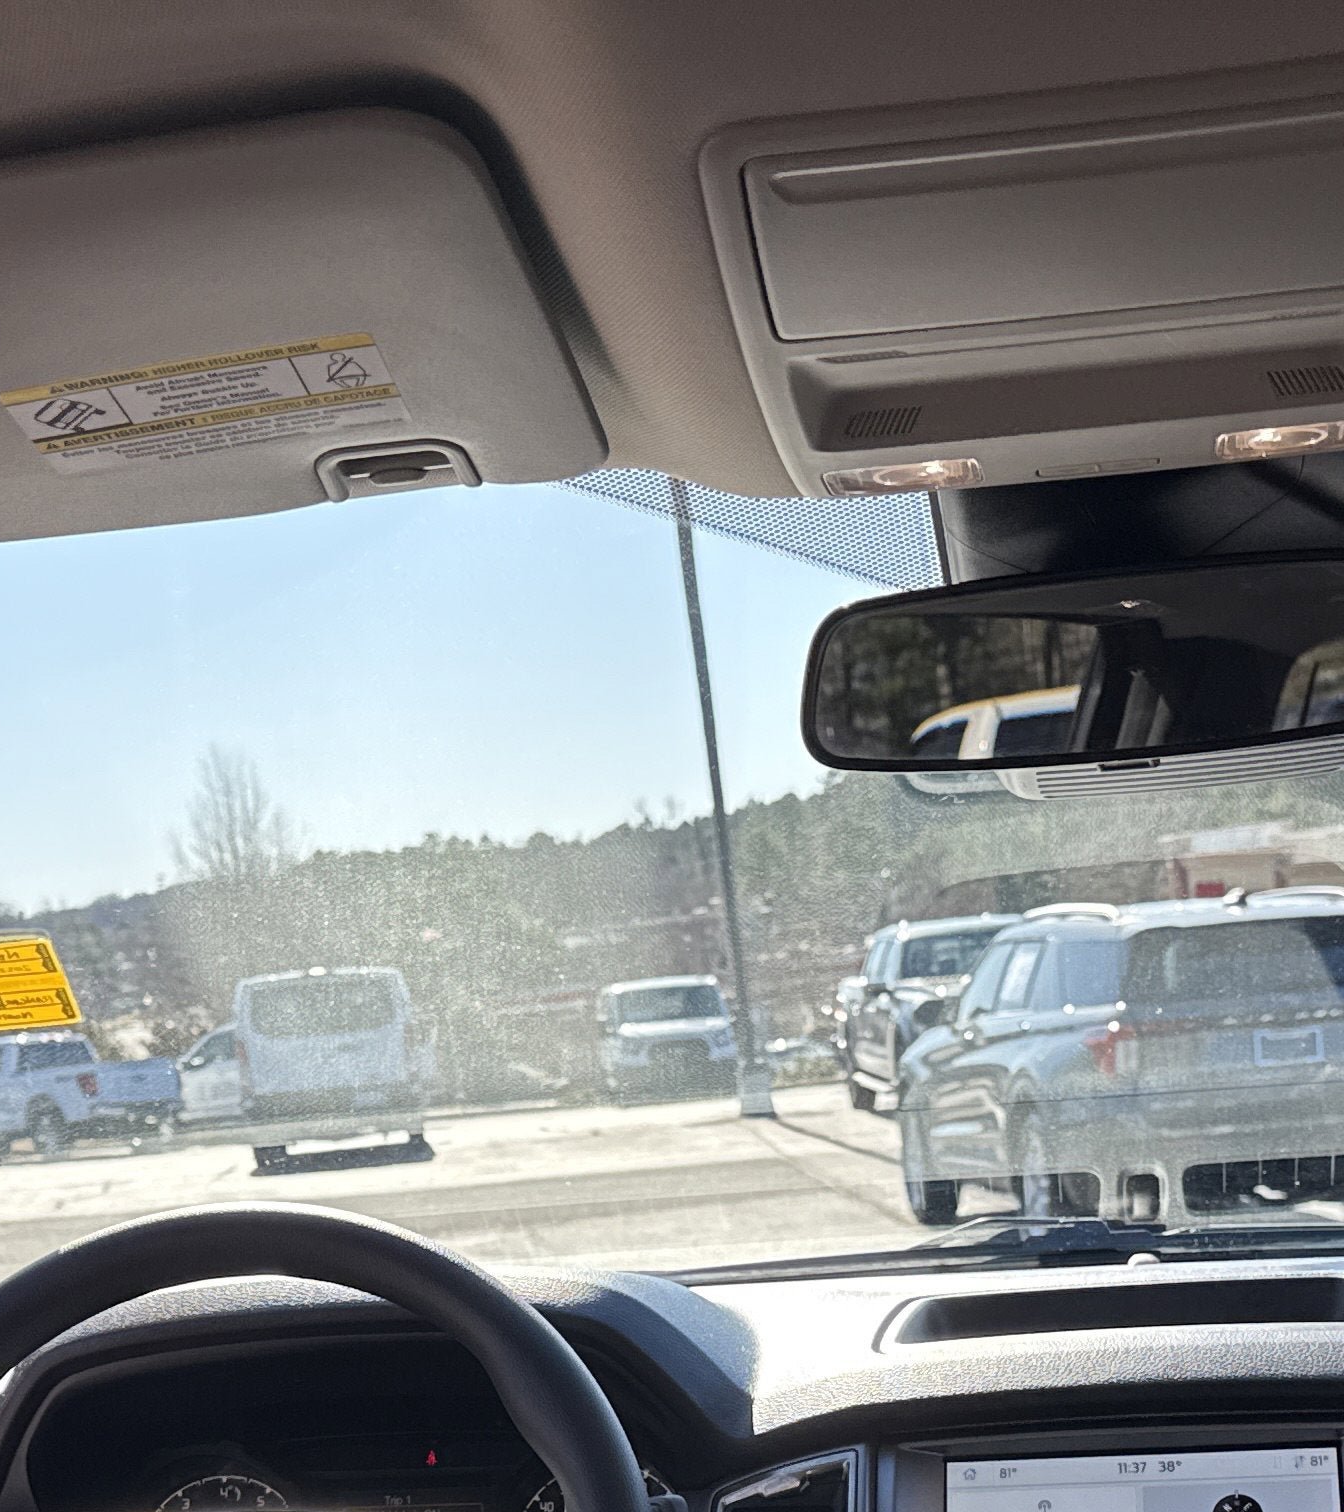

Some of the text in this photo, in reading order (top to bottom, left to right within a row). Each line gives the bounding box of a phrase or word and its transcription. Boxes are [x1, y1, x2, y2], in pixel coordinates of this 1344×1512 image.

[1117, 1461, 1147, 1474] 11:37
[182, 1498, 191, 1509] 3
[257, 1495, 265, 1507] 5
[384, 1495, 403, 1505] Trip
[540, 1501, 554, 1512] 40
